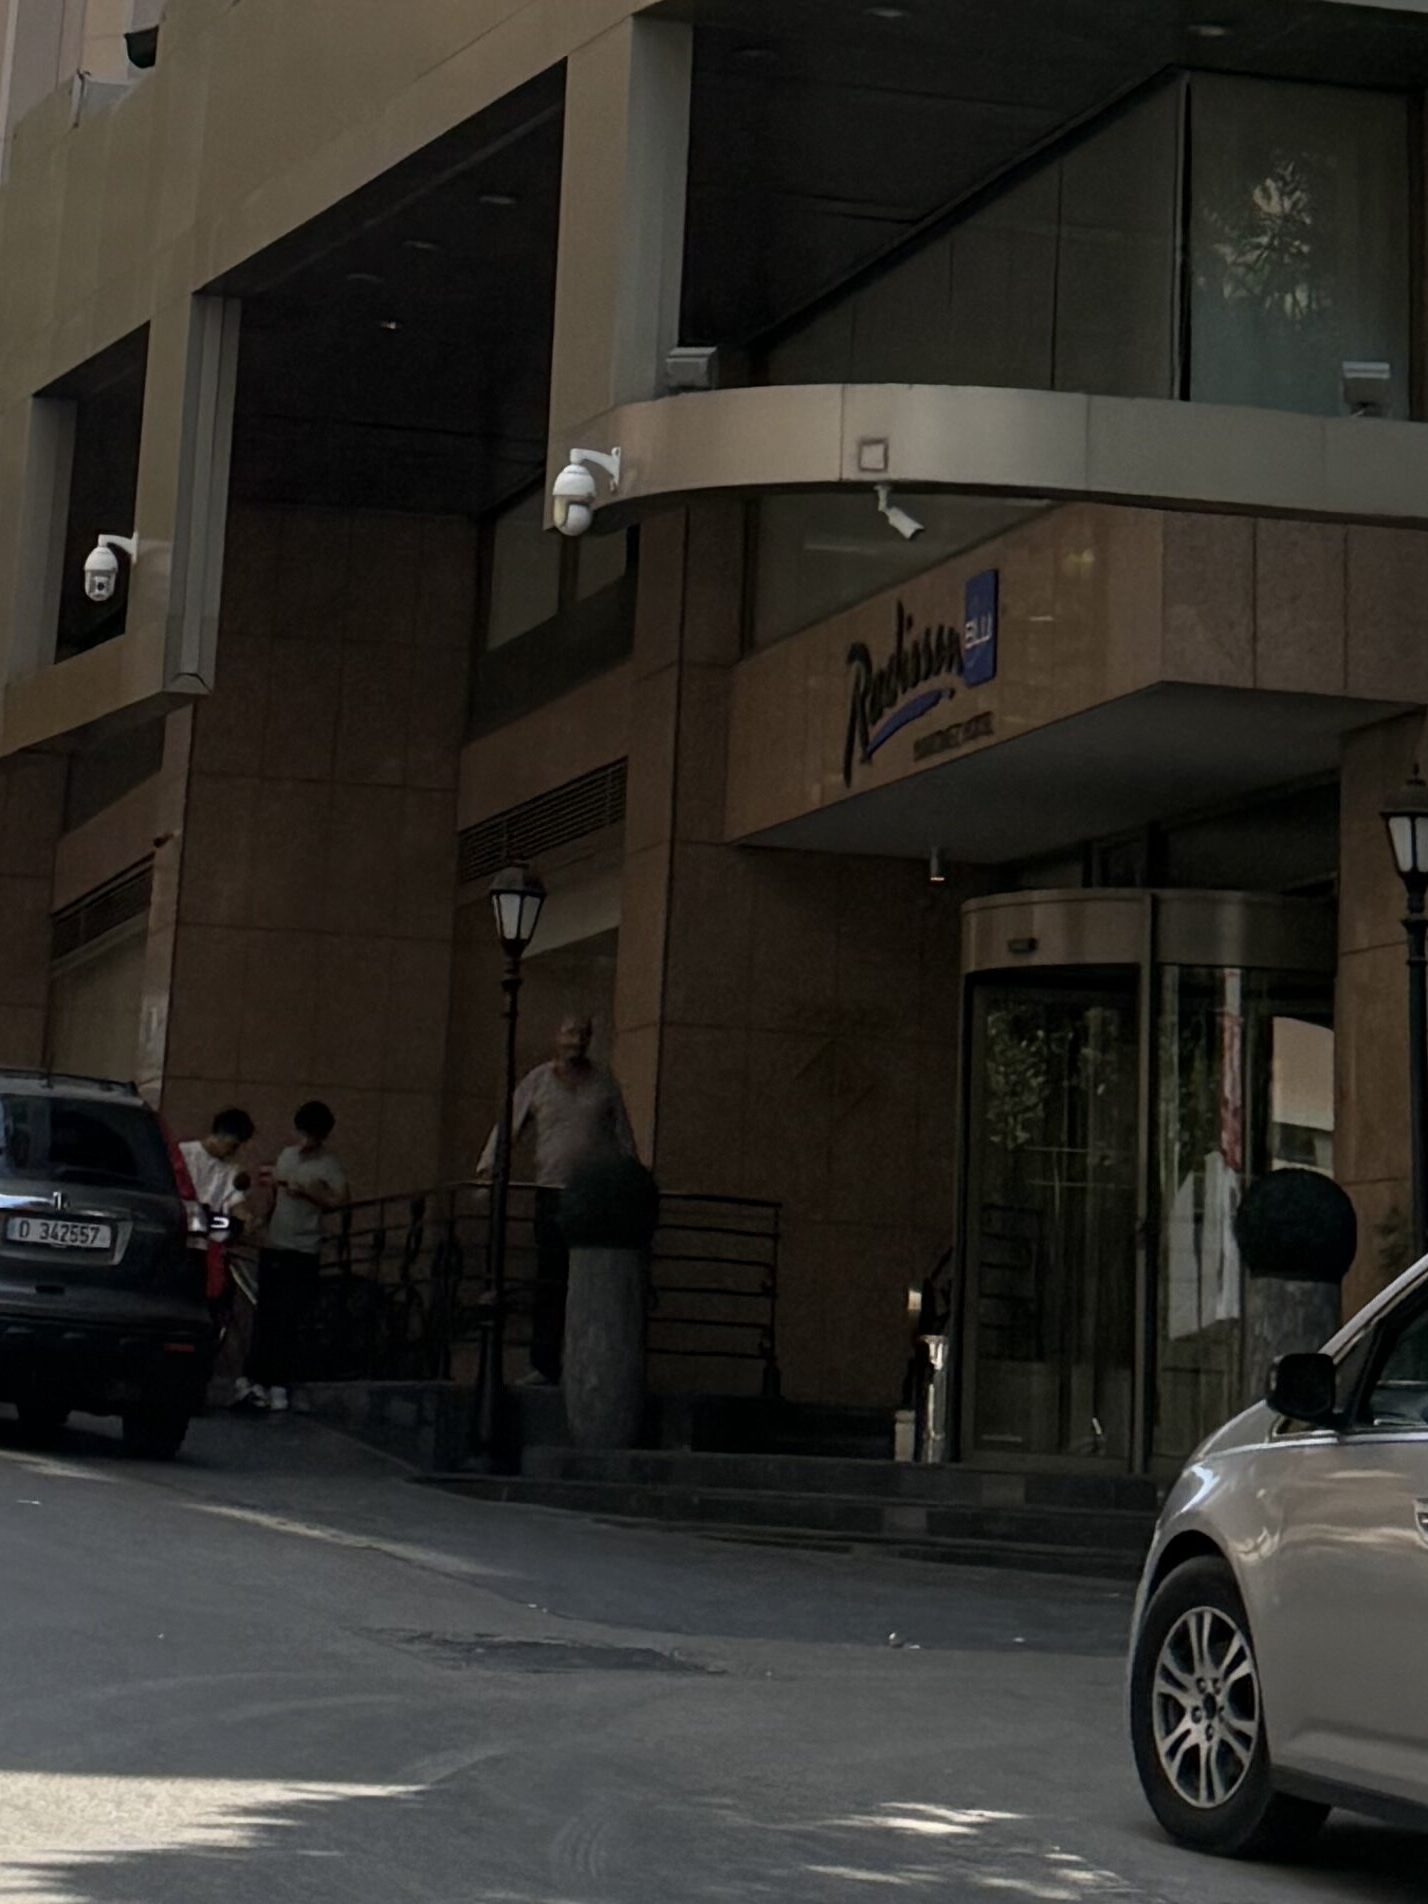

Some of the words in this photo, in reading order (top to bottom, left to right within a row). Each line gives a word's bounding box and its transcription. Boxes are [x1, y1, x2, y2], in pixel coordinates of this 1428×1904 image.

[842, 598, 964, 788] Radisson
[963, 612, 993, 649] BLU
[40, 1222, 101, 1244] 342557
